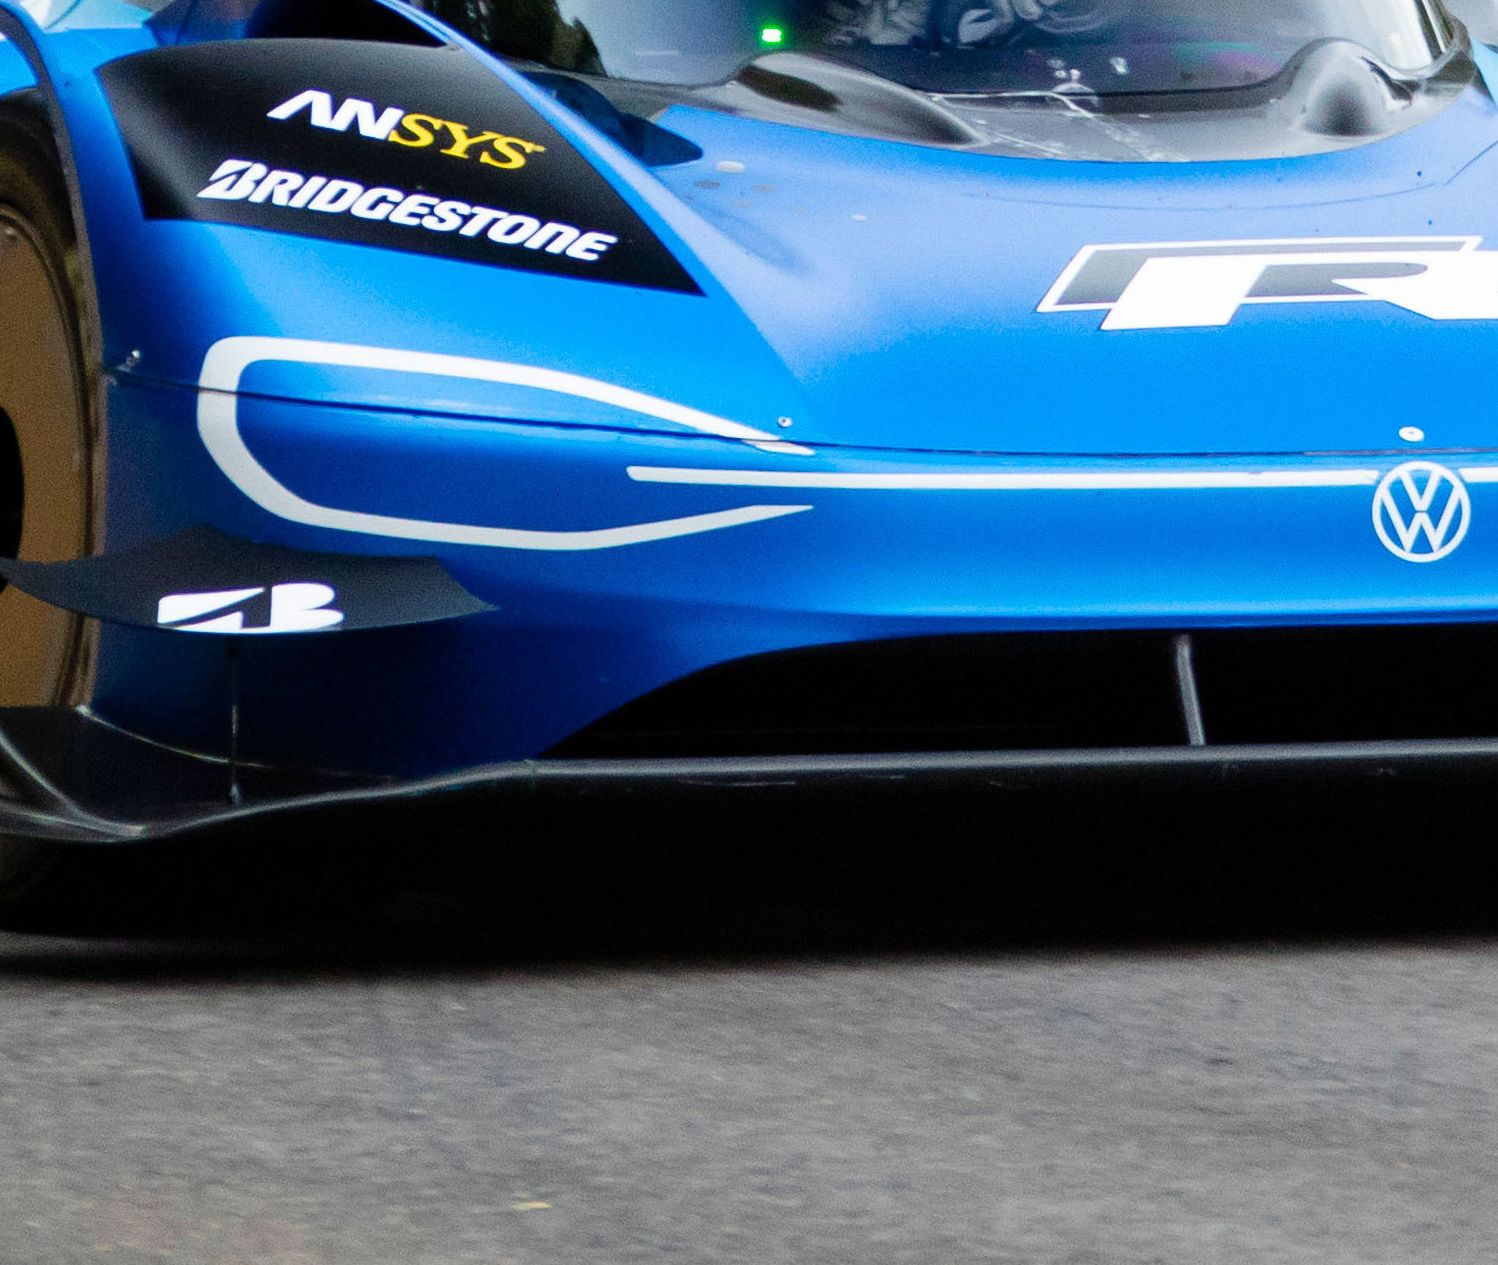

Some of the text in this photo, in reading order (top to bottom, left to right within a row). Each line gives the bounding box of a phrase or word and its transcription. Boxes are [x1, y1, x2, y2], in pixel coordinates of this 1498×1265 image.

[267, 90, 545, 170] ANSYS
[197, 159, 617, 261] BRIDGESTONE
[1374, 462, 1469, 562] VW
